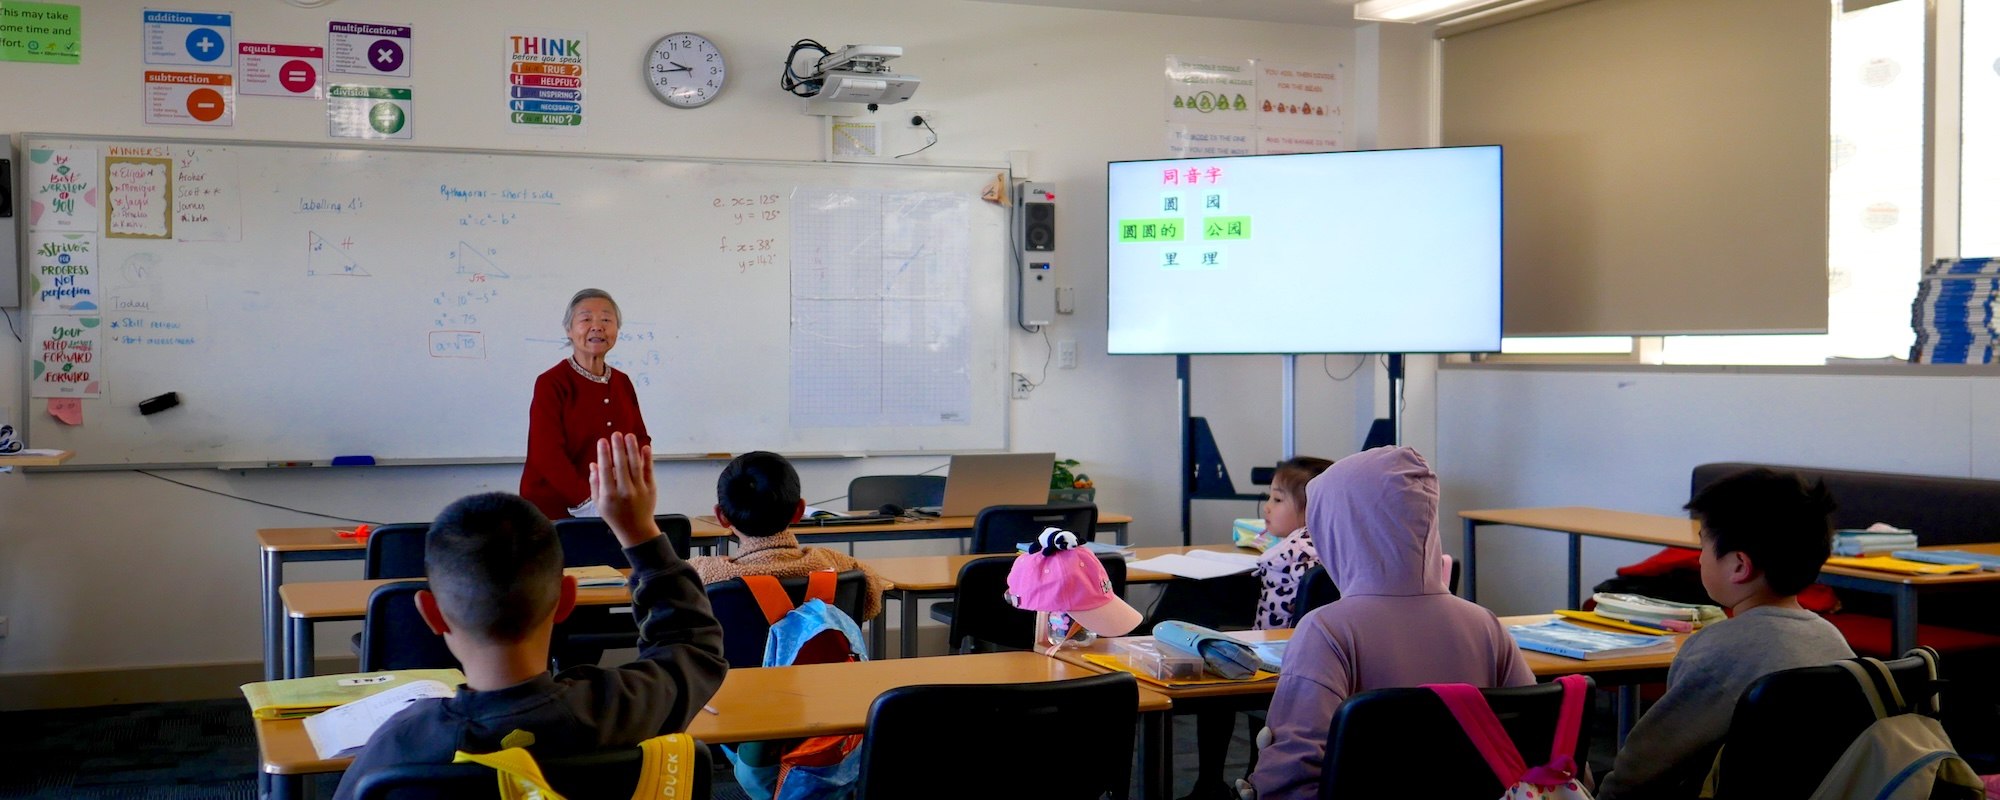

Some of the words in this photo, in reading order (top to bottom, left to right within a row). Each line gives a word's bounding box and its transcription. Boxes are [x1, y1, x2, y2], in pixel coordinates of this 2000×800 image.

[22, 11, 43, 20] may
[47, 11, 68, 20] take
[148, 13, 192, 23] addition
[26, 25, 49, 34] time
[53, 27, 71, 36] and
[333, 24, 397, 35] multiplication
[510, 36, 580, 56] THINK
[682, 40, 691, 48] 12
[243, 45, 276, 54] equals
[512, 53, 538, 61] before
[660, 51, 670, 59] 10
[706, 54, 713, 62] 2
[516, 63, 522, 73] T
[543, 65, 565, 74] TRUE
[656, 64, 664, 72] 9
[710, 67, 717, 75] 3
[149, 73, 209, 83] subtraction
[515, 76, 523, 85] H
[660, 77, 668, 85] 8
[706, 79, 713, 87] 4
[334, 88, 369, 97] division
[671, 86, 677, 95] 7
[697, 88, 704, 96] 5
[515, 101, 524, 111] N
[516, 113, 524, 122] K
[1163, 166, 1222, 185] 同音字
[1206, 194, 1220, 209] 园
[1207, 221, 1242, 237] 公园
[1163, 252, 1180, 266] 里
[1202, 252, 1219, 266] 理
[41, 265, 89, 275] PROGRESS
[41, 286, 91, 302] perfection
[111, 296, 150, 310] Today
[44, 351, 93, 363] FORWARD
[46, 371, 91, 383] FORWARD
[664, 753, 679, 797] DUCK
